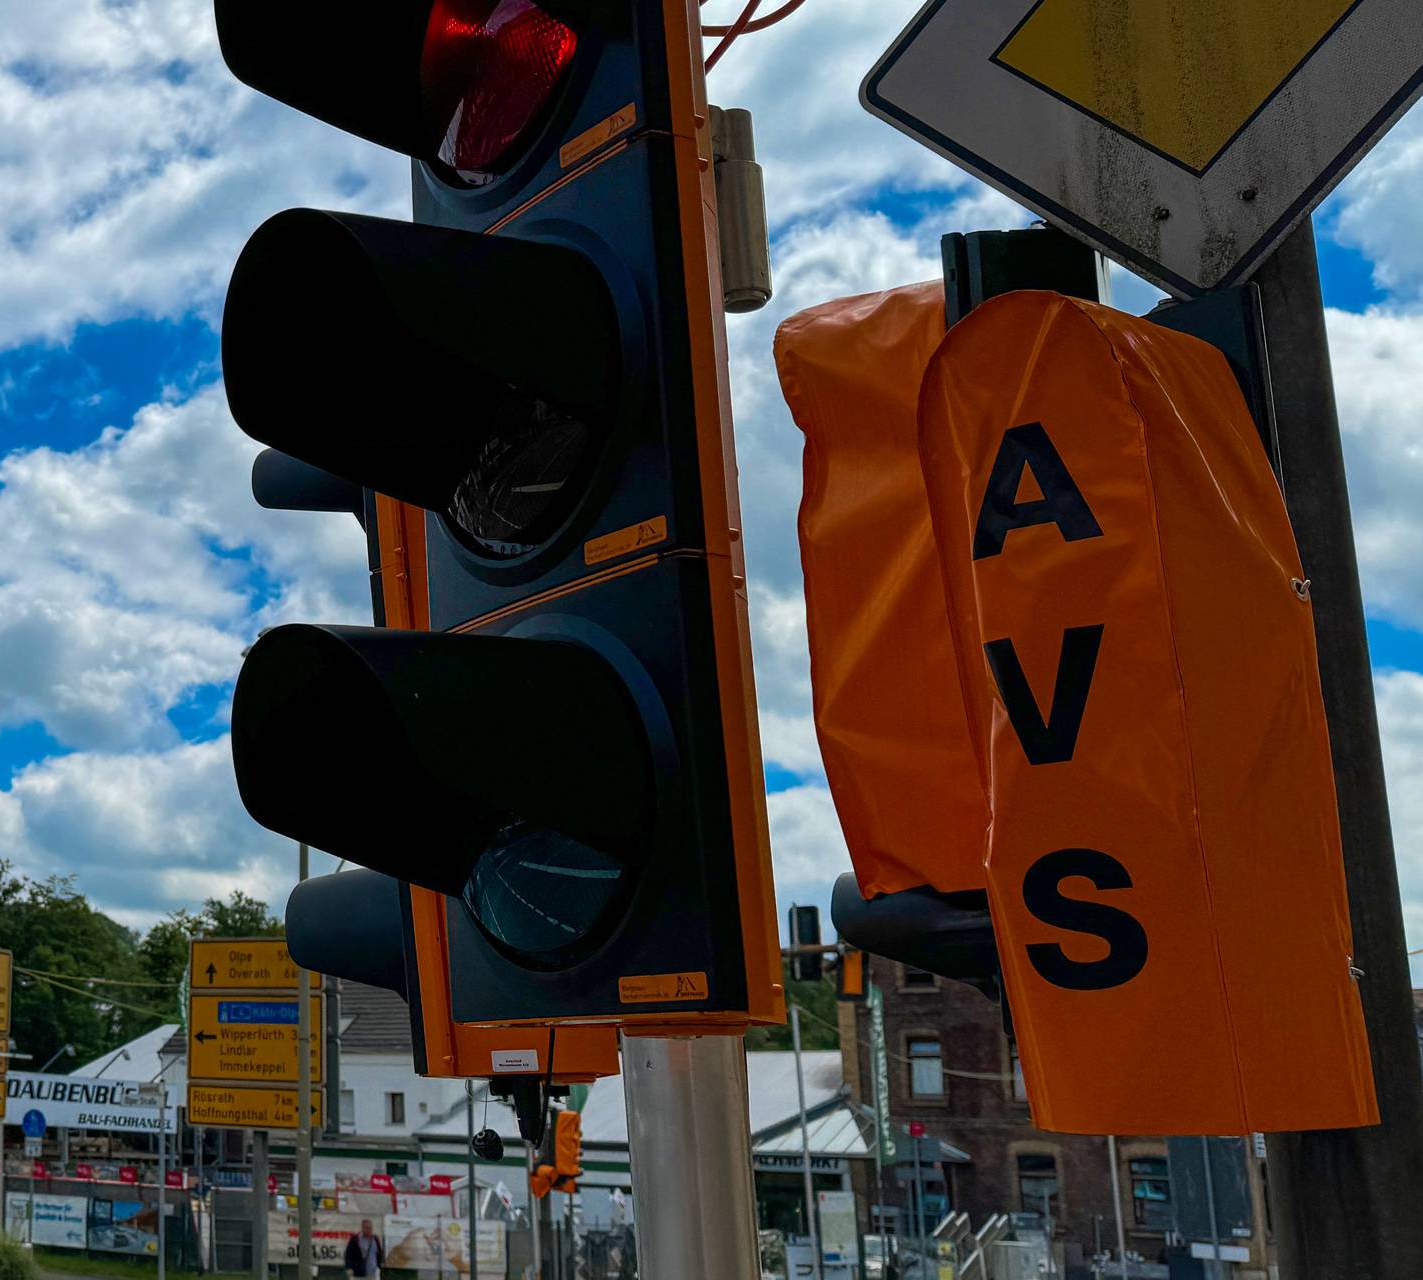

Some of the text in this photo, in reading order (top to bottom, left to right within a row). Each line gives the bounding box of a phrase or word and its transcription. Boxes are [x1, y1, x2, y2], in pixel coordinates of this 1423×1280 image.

[229, 950, 253, 963] Olpe
[229, 967, 271, 979] Overath
[252, 1006, 300, 1020] Köln-Olp
[220, 1044, 257, 1057] Lindlar
[219, 1060, 286, 1075] Immekeppel
[7, 1078, 173, 1110] DAUBENBÜL
[193, 1105, 267, 1122] Hoffnungsthal
[78, 1113, 173, 1130] BAU-FACHHANDL
